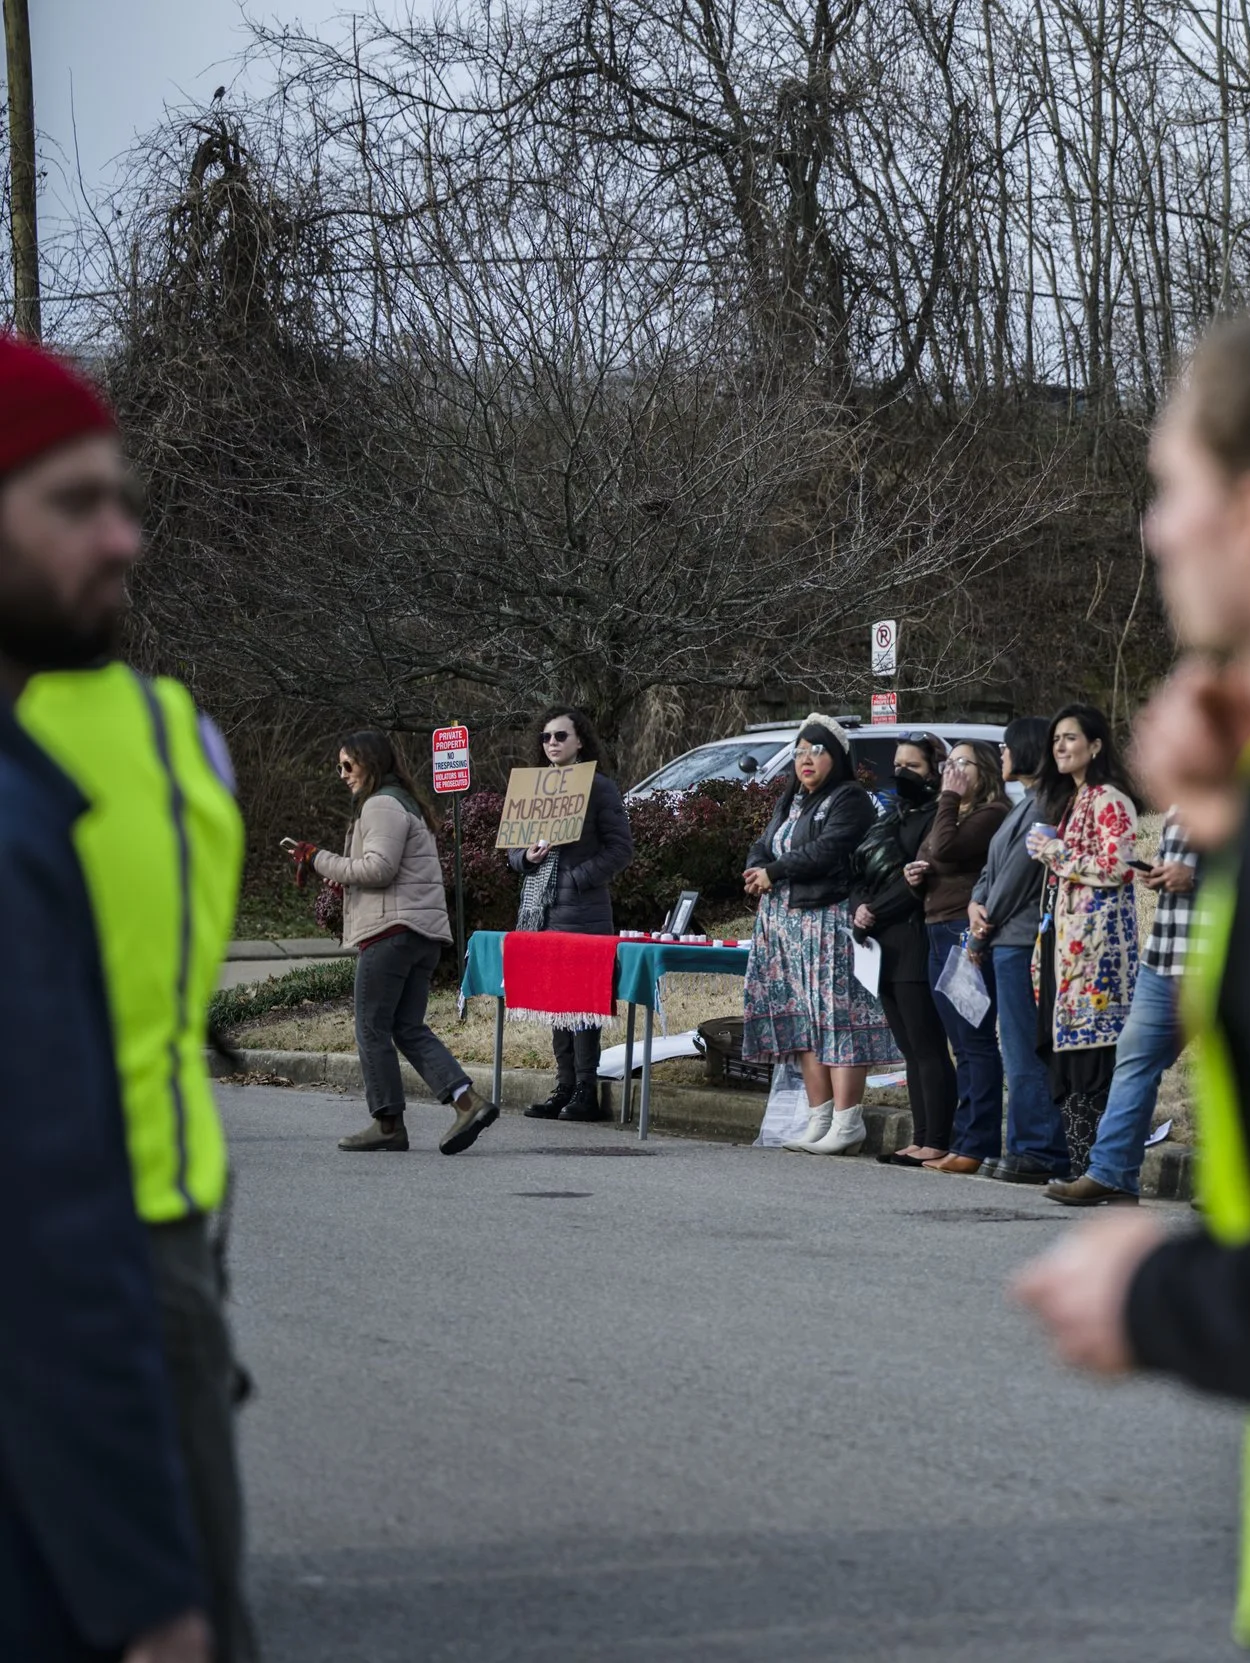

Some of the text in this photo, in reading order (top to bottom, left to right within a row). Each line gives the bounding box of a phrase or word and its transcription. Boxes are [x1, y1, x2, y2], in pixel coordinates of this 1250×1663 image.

[438, 730, 463, 741] PRIVATE
[435, 739, 466, 751] PROPERTY
[447, 751, 455, 760] NO
[435, 760, 467, 770] TRESPASSING
[435, 770, 468, 781] VIOLATORS WILL
[435, 781, 442, 789] BE
[534, 767, 574, 796] ICE
[506, 793, 586, 820] MURDERED
[497, 816, 584, 846] RENEE GOOD
